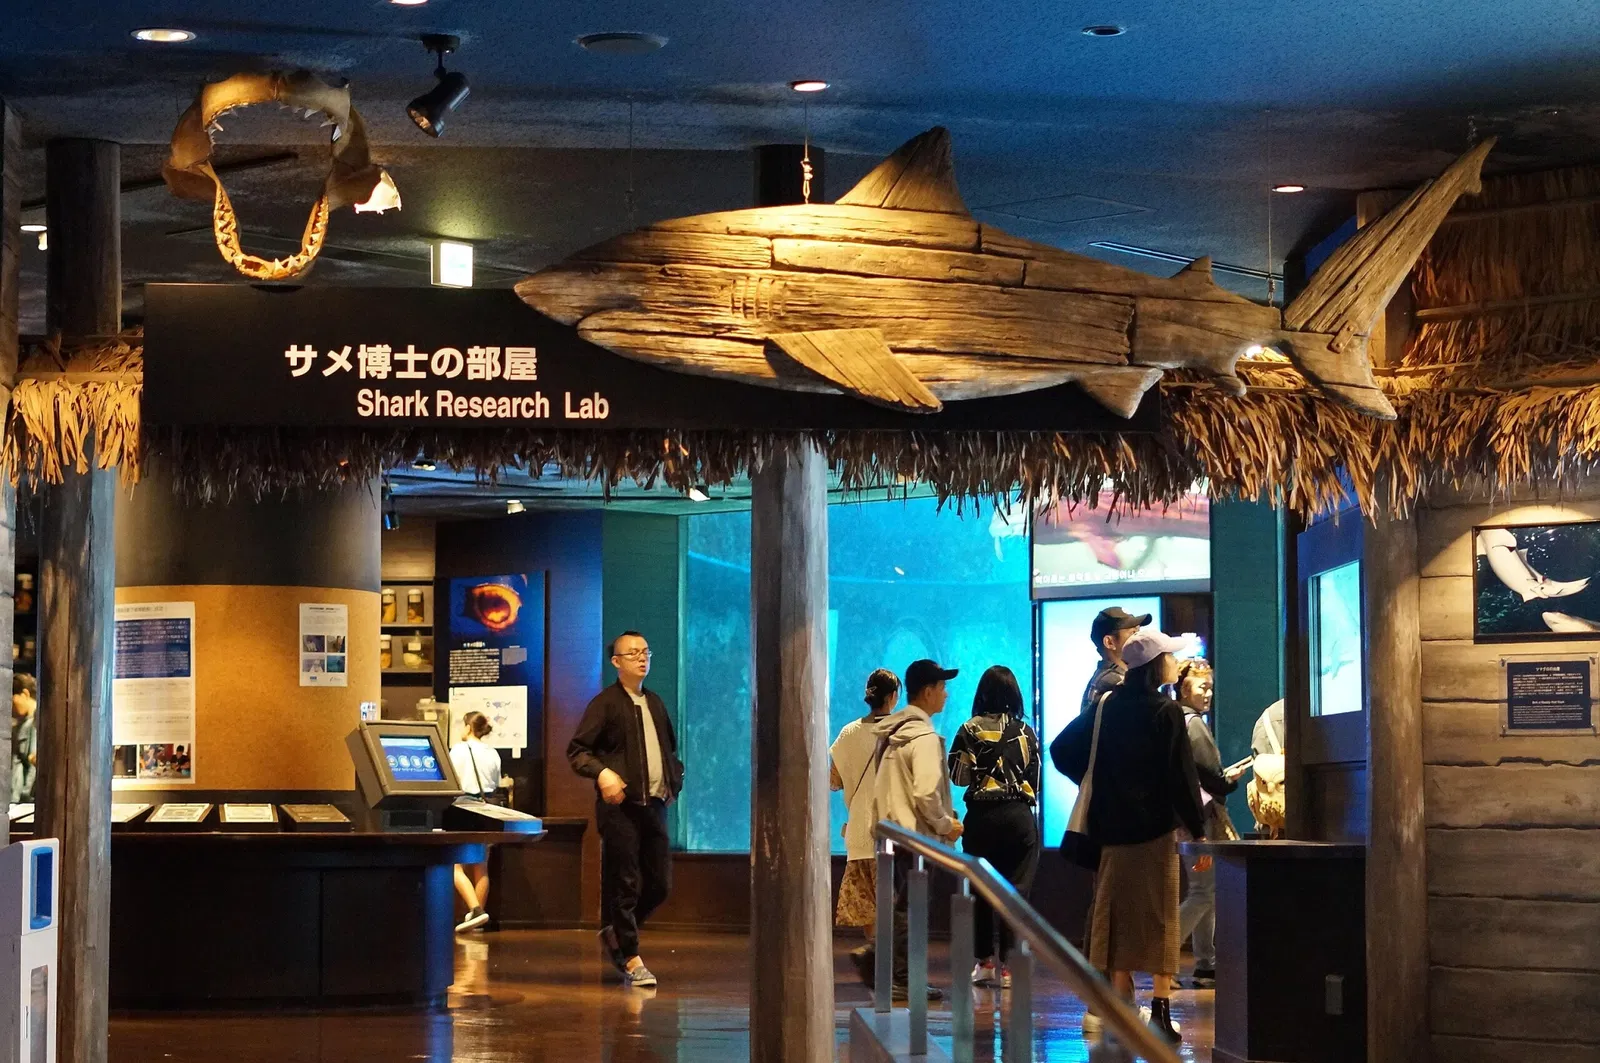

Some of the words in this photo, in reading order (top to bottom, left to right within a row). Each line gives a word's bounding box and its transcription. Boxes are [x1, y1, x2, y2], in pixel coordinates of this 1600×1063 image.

[284, 343, 538, 381] サメ博士の部屋
[357, 388, 429, 417] Shark
[436, 389, 550, 419] Research
[564, 391, 610, 420] Lab
